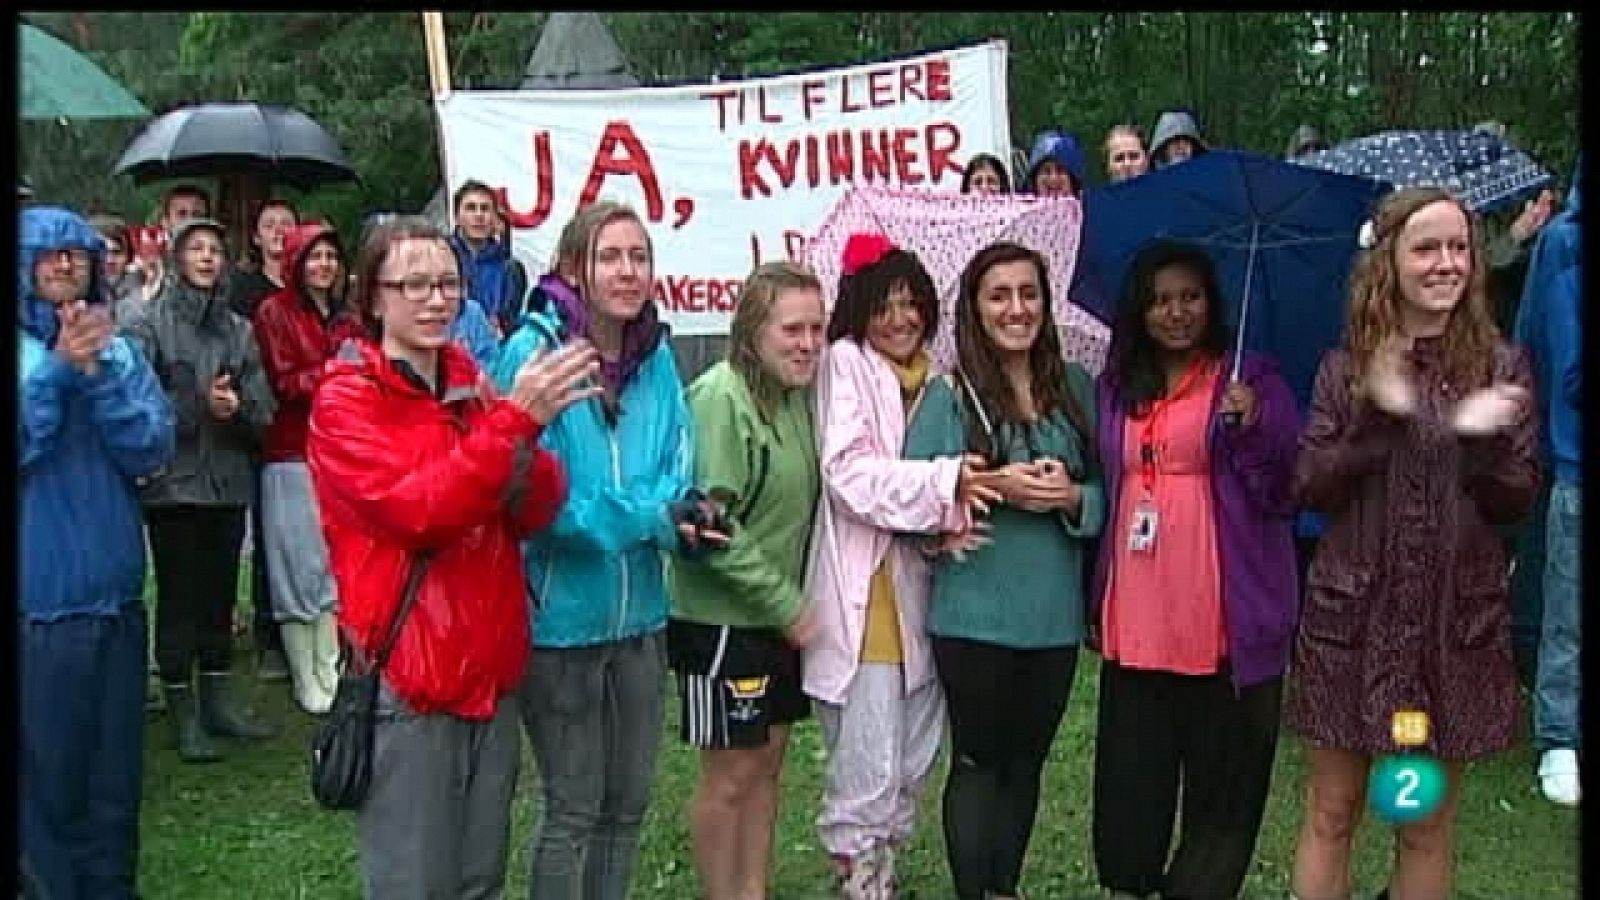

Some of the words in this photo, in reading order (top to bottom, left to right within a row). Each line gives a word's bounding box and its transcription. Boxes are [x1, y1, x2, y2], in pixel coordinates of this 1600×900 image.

[706, 85, 783, 131] TIL
[802, 59, 951, 120] FLERE
[496, 121, 695, 230] JA,
